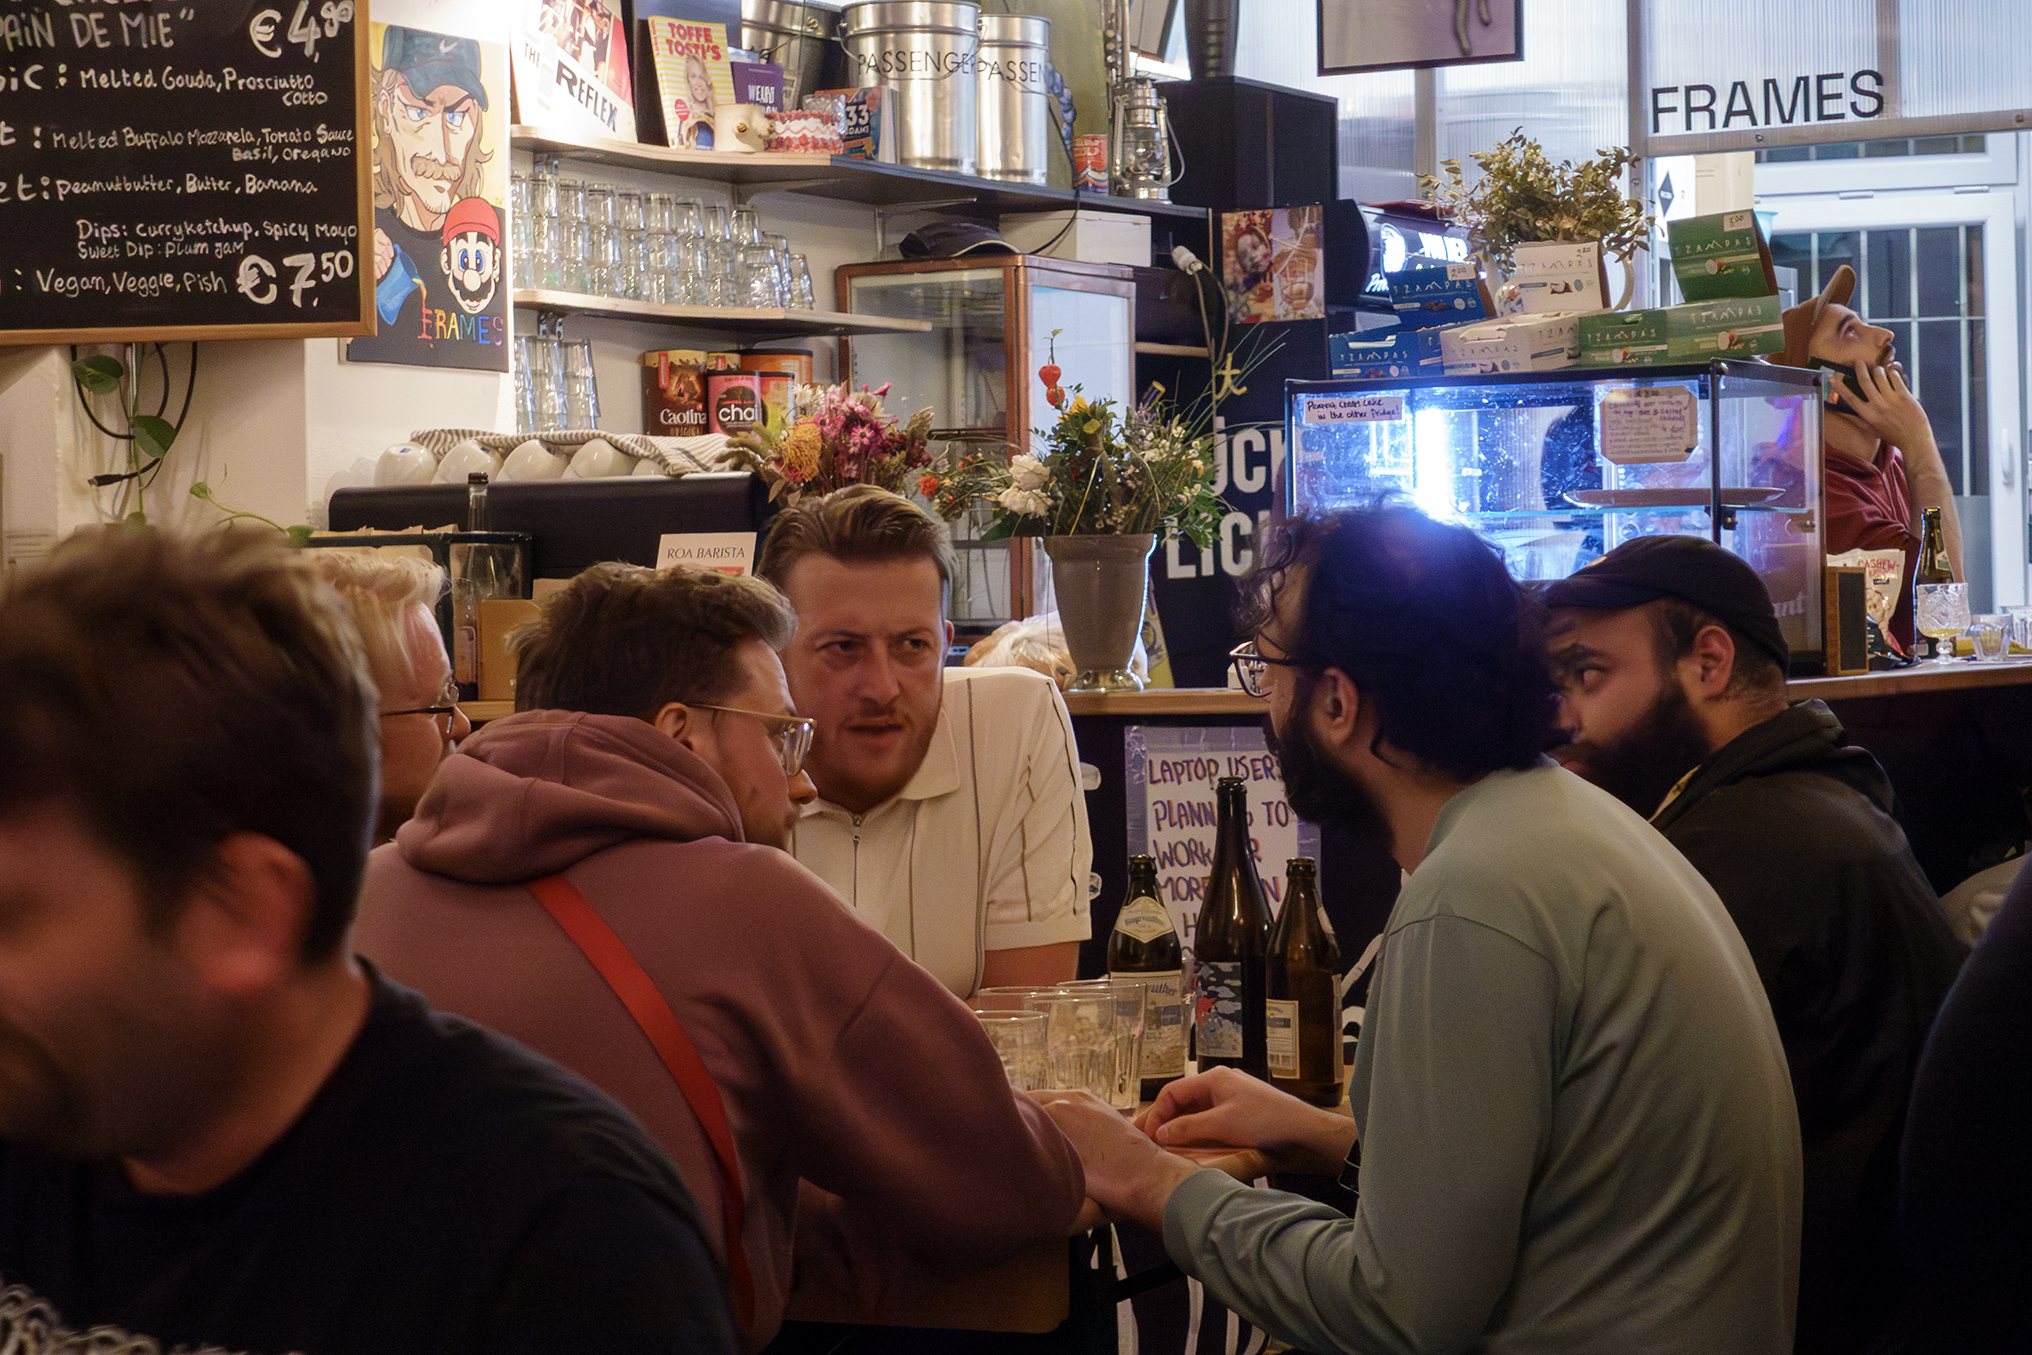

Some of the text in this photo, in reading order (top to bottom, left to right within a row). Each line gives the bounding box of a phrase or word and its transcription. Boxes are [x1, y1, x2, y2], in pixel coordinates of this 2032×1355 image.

[69, 12, 111, 48] DE
[667, 21, 713, 44] TOFFE
[524, 41, 541, 69] THE
[665, 38, 722, 61] TOSTI'S
[80, 67, 157, 89] Melted
[222, 67, 315, 91] Prosciutto
[556, 59, 619, 134] REFLEX
[1652, 69, 1885, 133] FRAMES
[845, 105, 870, 126] 33
[52, 130, 118, 150] Melted
[121, 126, 185, 150] Buffalo
[316, 123, 354, 145] Sauce
[245, 173, 319, 195] Banana
[417, 308, 504, 347] FRAMES
[660, 408, 707, 426] Caotina
[1330, 411, 1344, 419] the
[667, 546, 745, 560] ROA BARISTA
[1149, 757, 1219, 786] LAPTOP
[1262, 799, 1289, 828] TO
[1152, 837, 1213, 871] WORK
